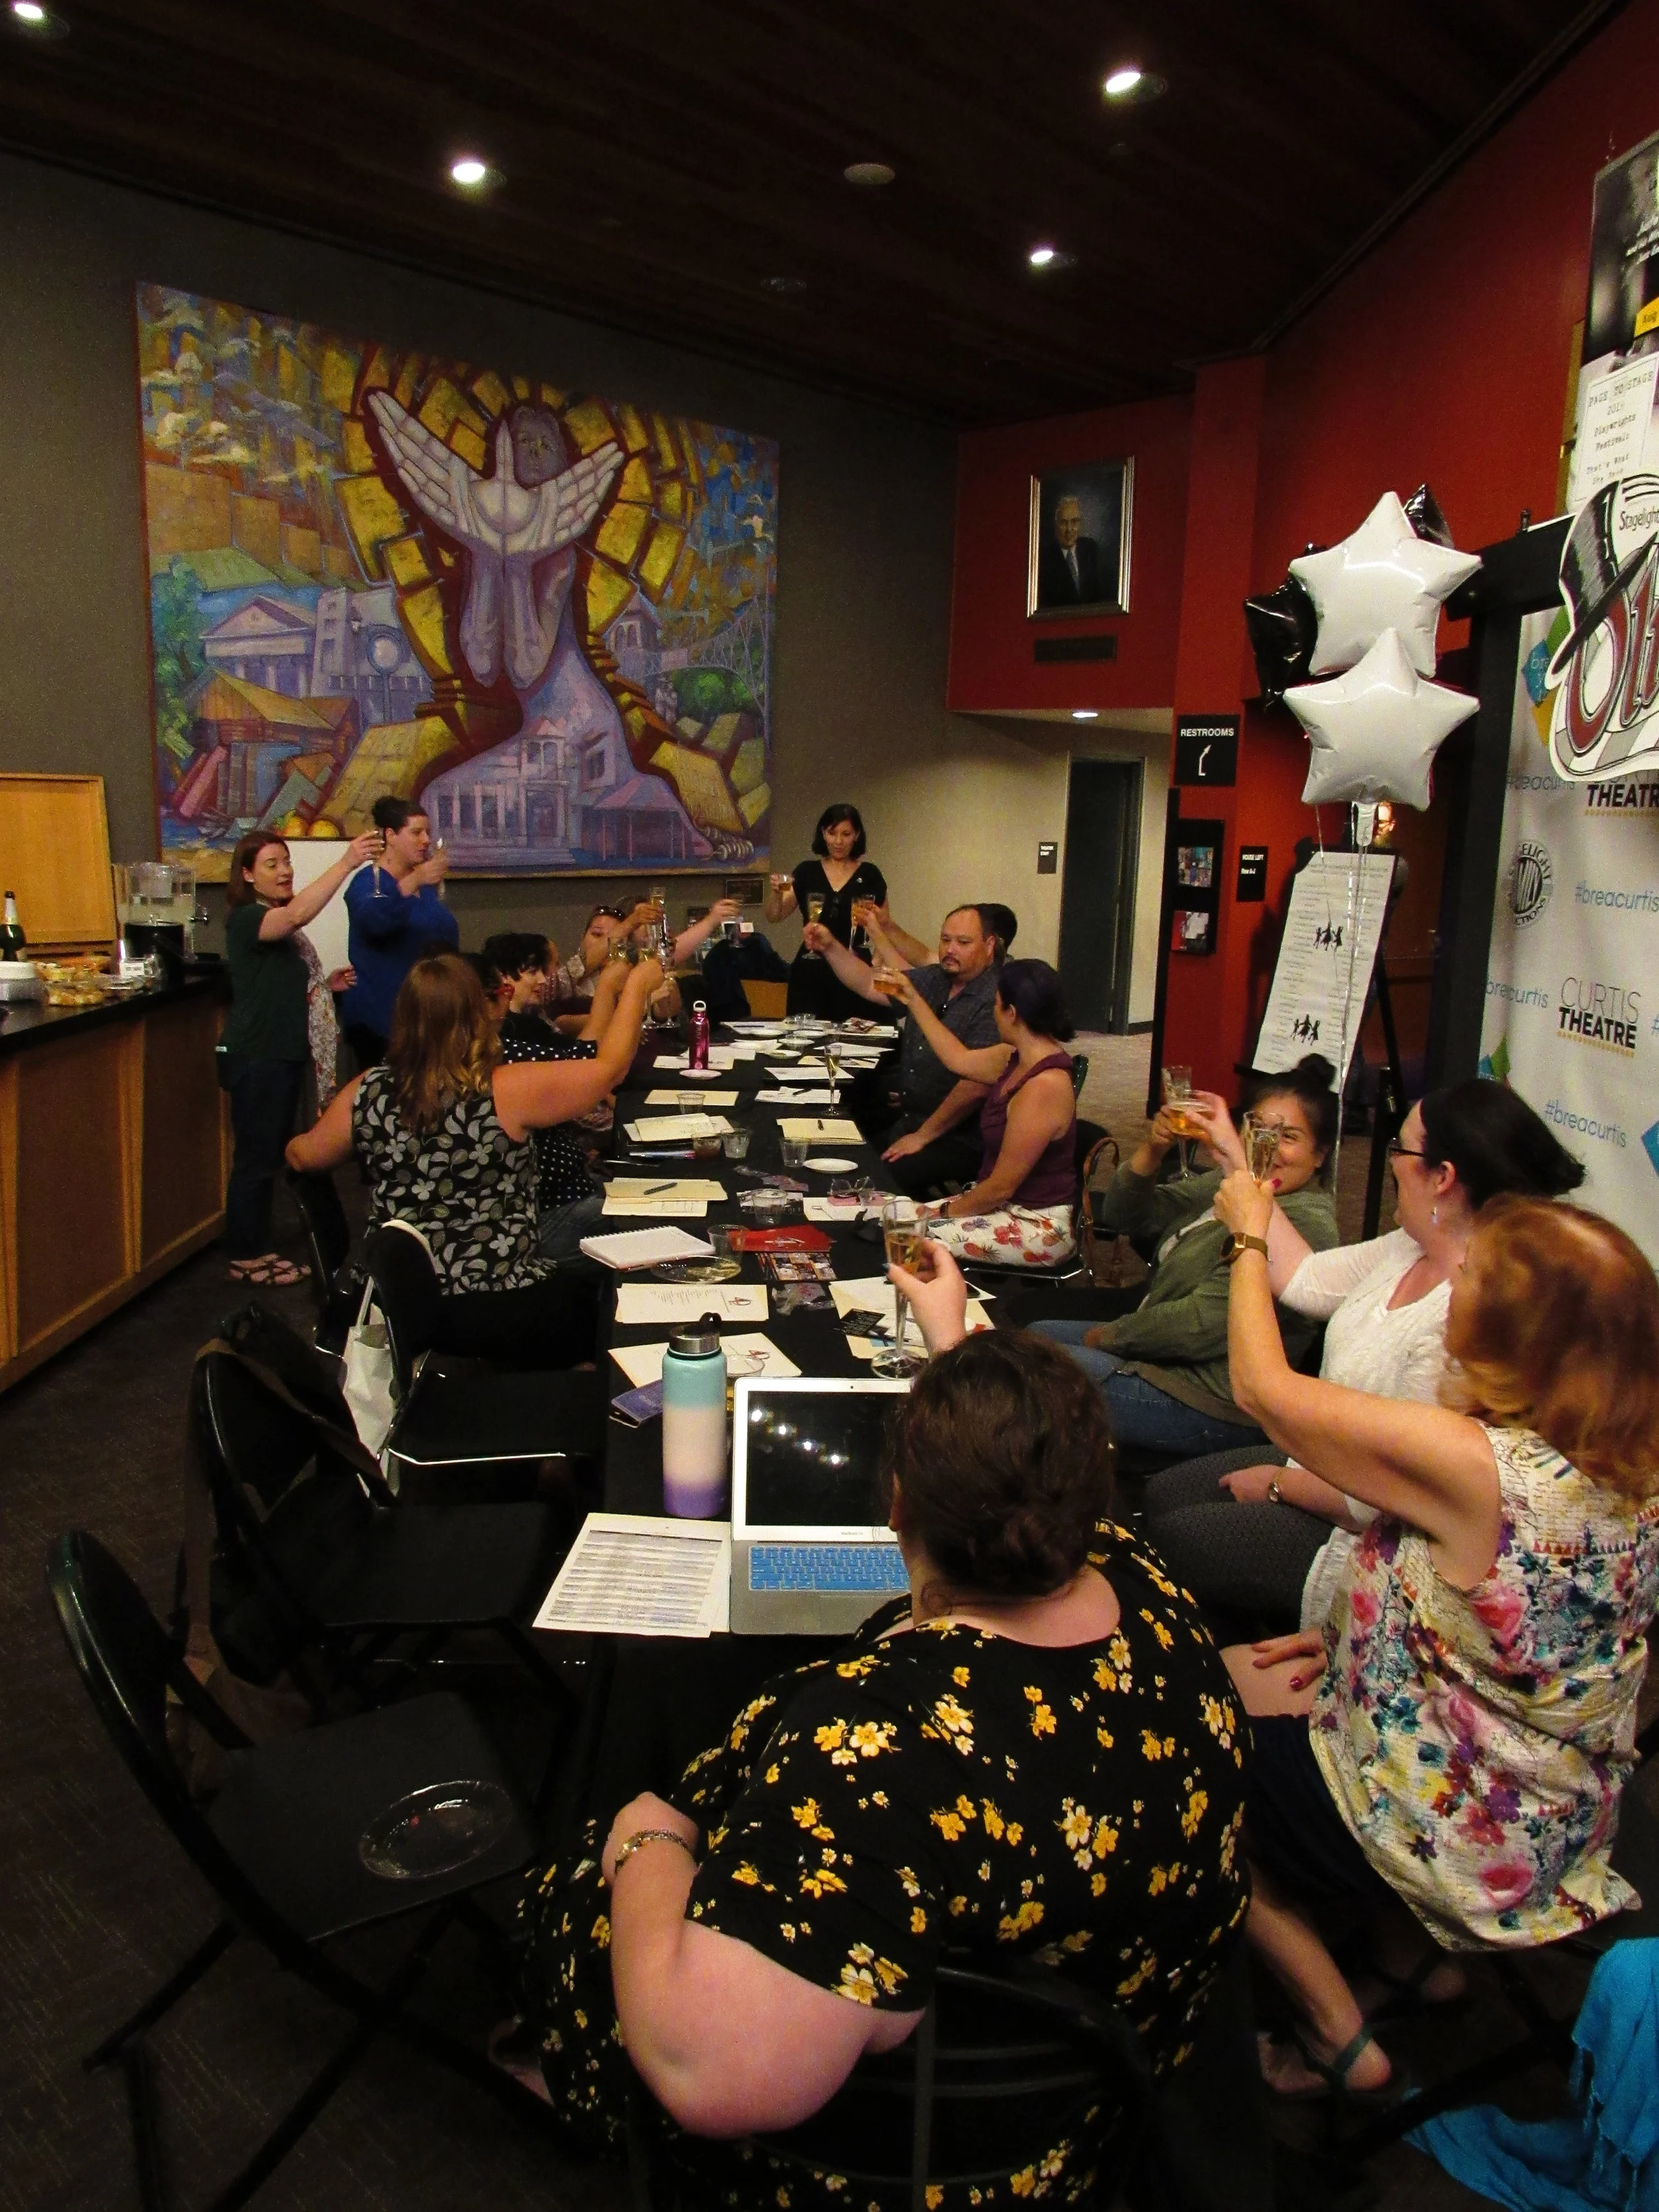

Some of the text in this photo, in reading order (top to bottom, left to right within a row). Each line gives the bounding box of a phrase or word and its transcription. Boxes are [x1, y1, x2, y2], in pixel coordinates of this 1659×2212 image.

[1627, 370, 1654, 390] STAGE
[1181, 727, 1234, 737] RESTROOMS
[1561, 977, 1642, 1024] CURTIS
[1559, 1006, 1637, 1049] THEATRE
[1544, 1098, 1627, 1148] #breacurtis
